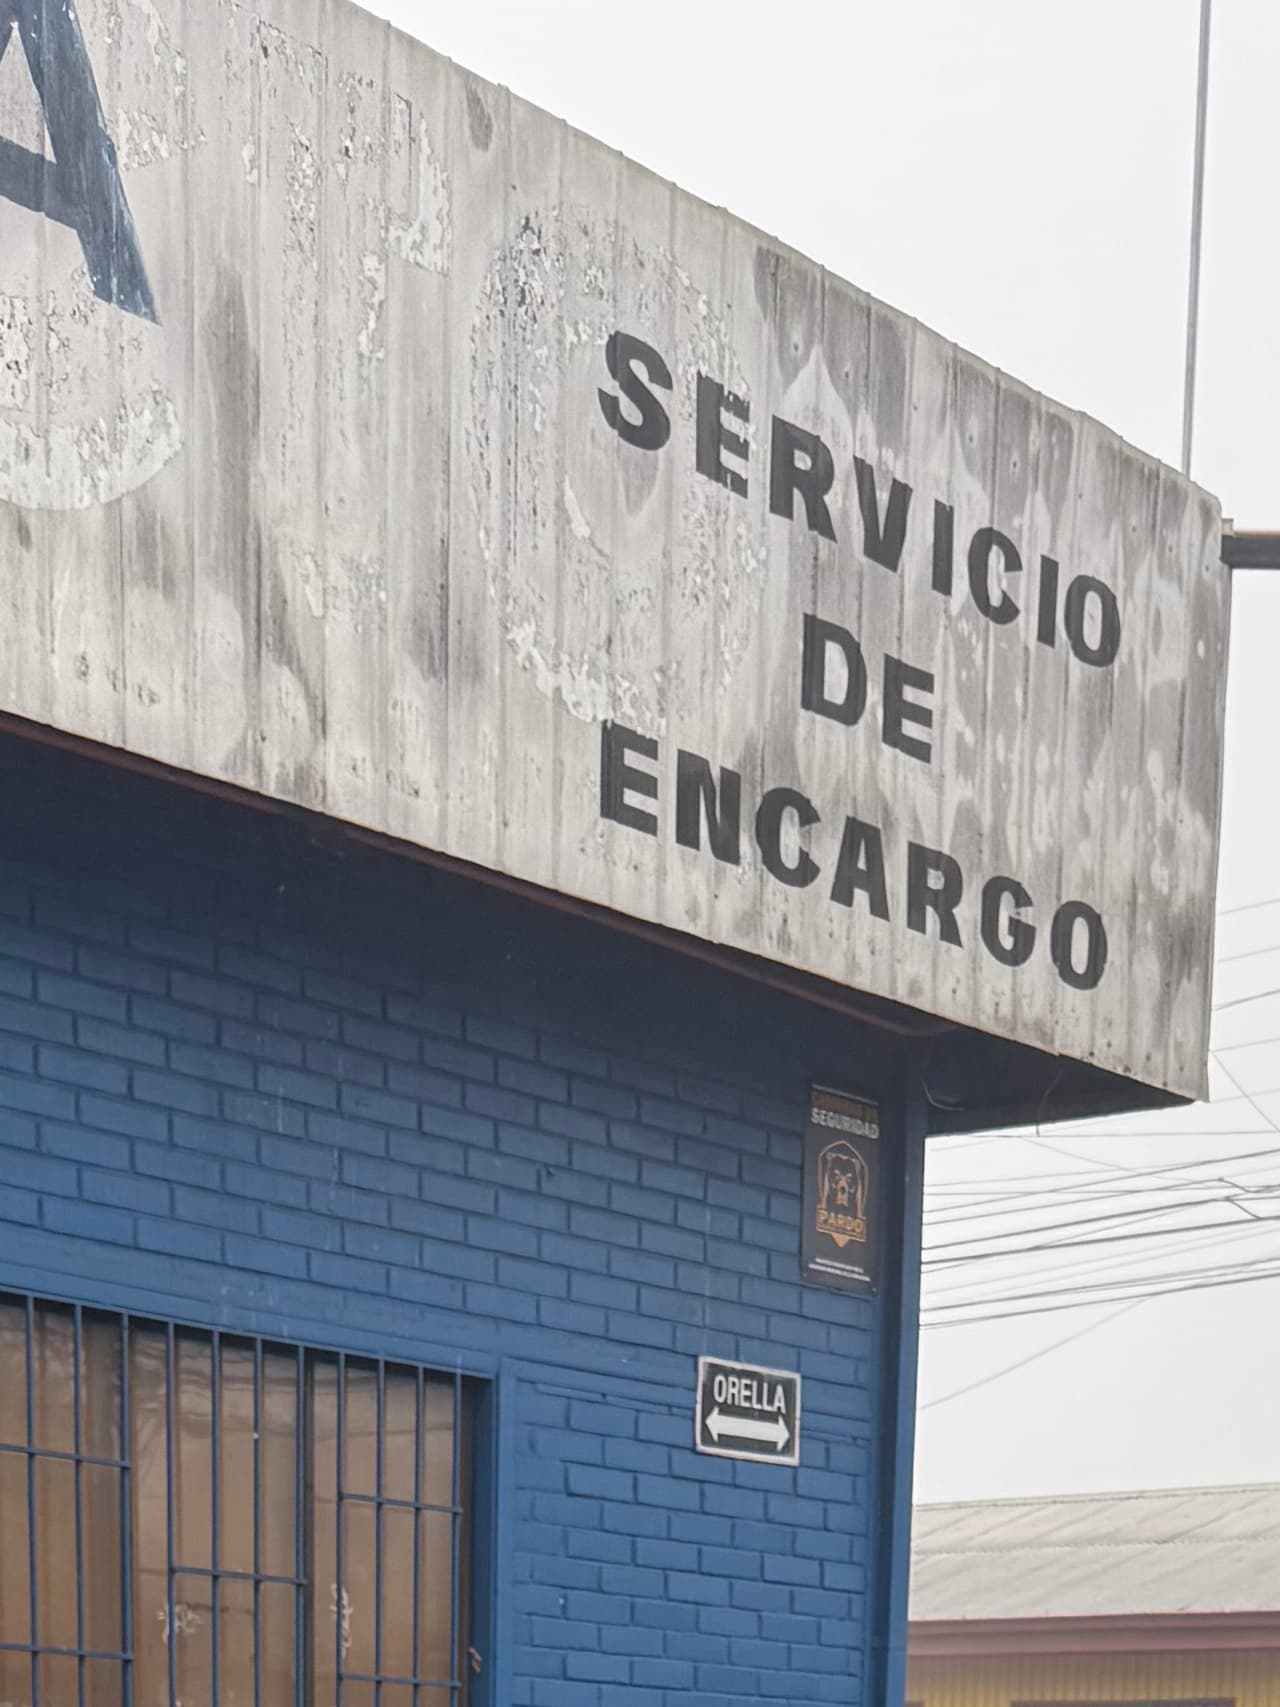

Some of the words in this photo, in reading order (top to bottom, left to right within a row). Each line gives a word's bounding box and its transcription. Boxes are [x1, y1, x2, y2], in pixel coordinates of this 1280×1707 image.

[597, 330, 1122, 669] SERVICIO
[801, 612, 936, 764] DE
[599, 719, 1109, 991] ENCARGO
[811, 1107, 880, 1139] SEGURIDAD
[818, 1209, 863, 1233] PARDO
[713, 1375, 786, 1413] ORELLA
